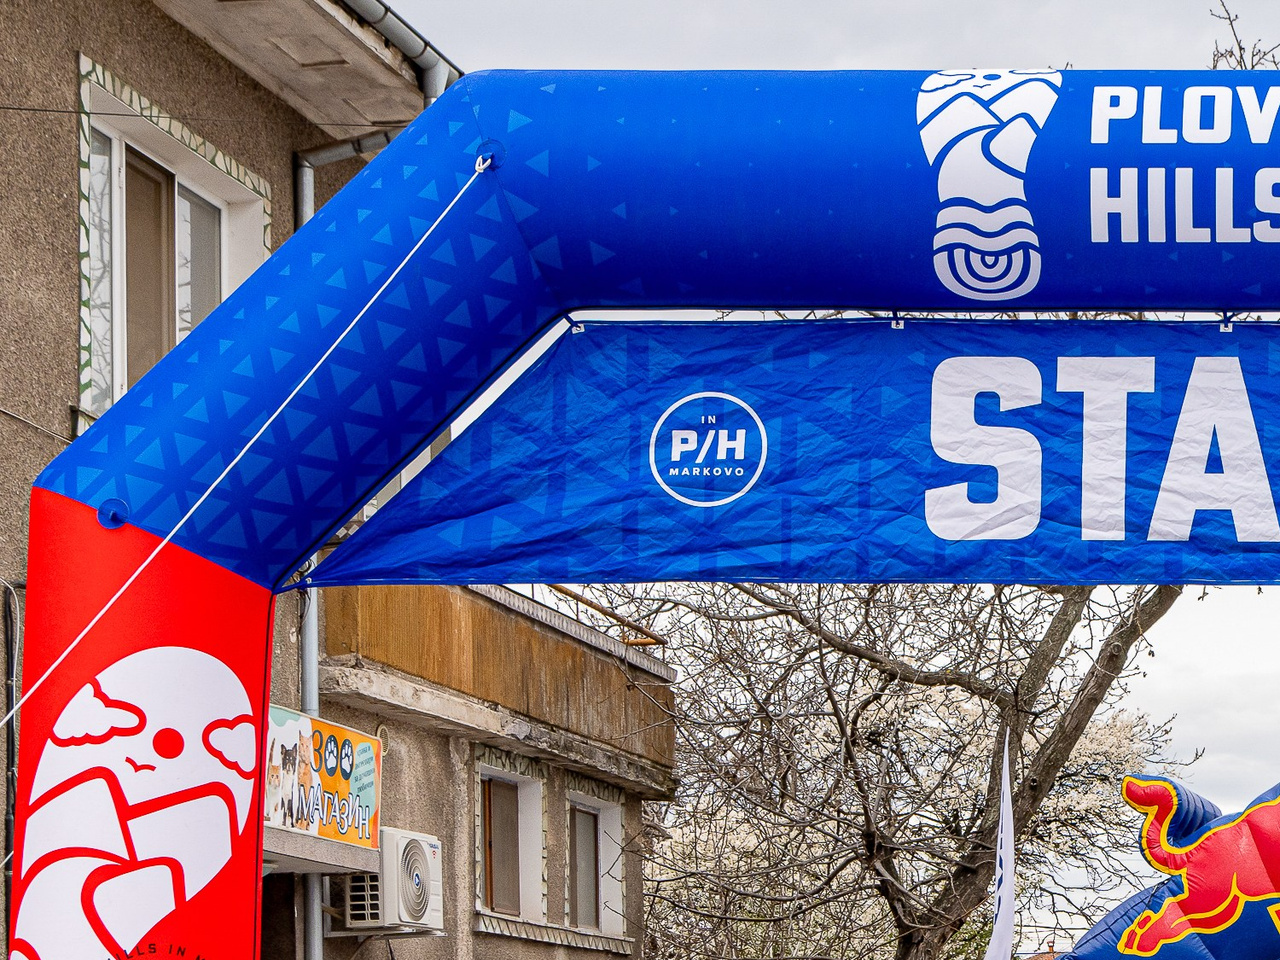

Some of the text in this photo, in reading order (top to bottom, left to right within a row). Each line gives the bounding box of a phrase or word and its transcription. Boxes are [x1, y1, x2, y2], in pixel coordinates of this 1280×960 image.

[701, 415, 716, 424] IN
[671, 429, 746, 464] P/H
[669, 467, 744, 476] MARKOVO
[298, 783, 371, 840] МАГАЗИН
[168, 944, 187, 957] IN
